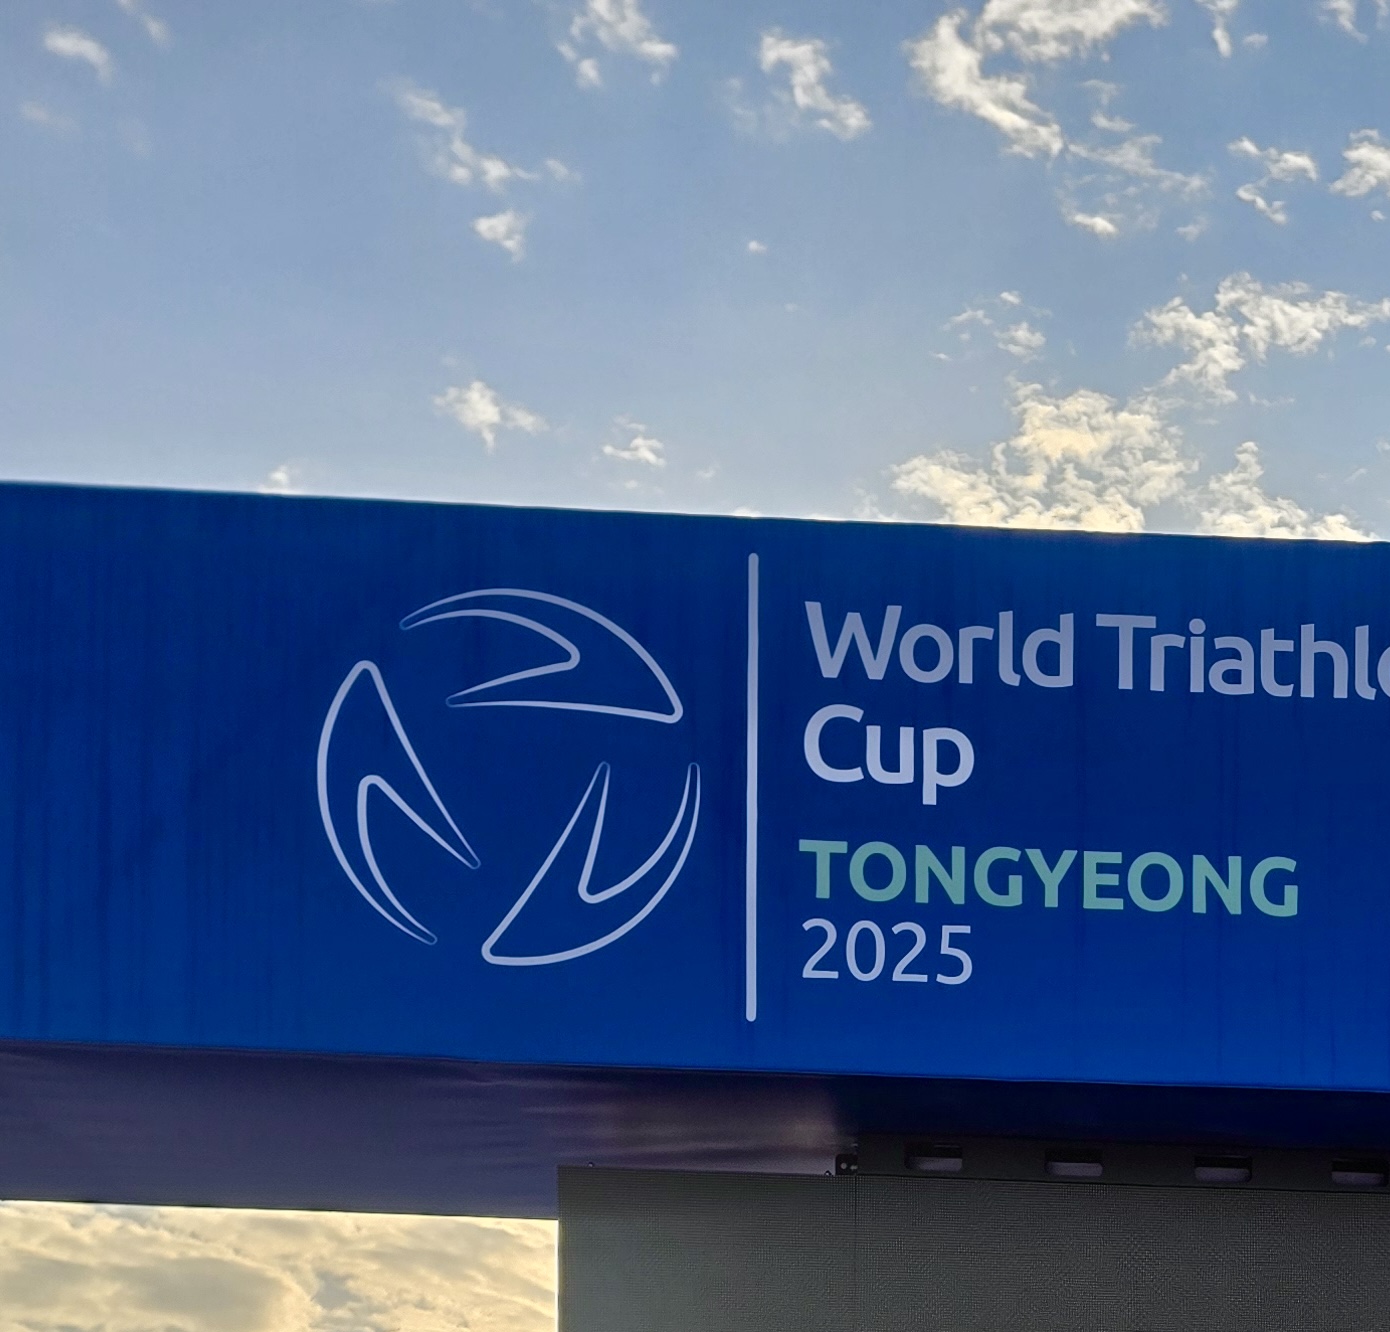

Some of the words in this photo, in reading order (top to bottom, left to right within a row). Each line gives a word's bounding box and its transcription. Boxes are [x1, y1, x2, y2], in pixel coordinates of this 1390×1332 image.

[804, 600, 1073, 689] World
[803, 704, 975, 805] Cup
[798, 839, 1299, 917] TONGYEONG
[802, 918, 973, 985] 2025
